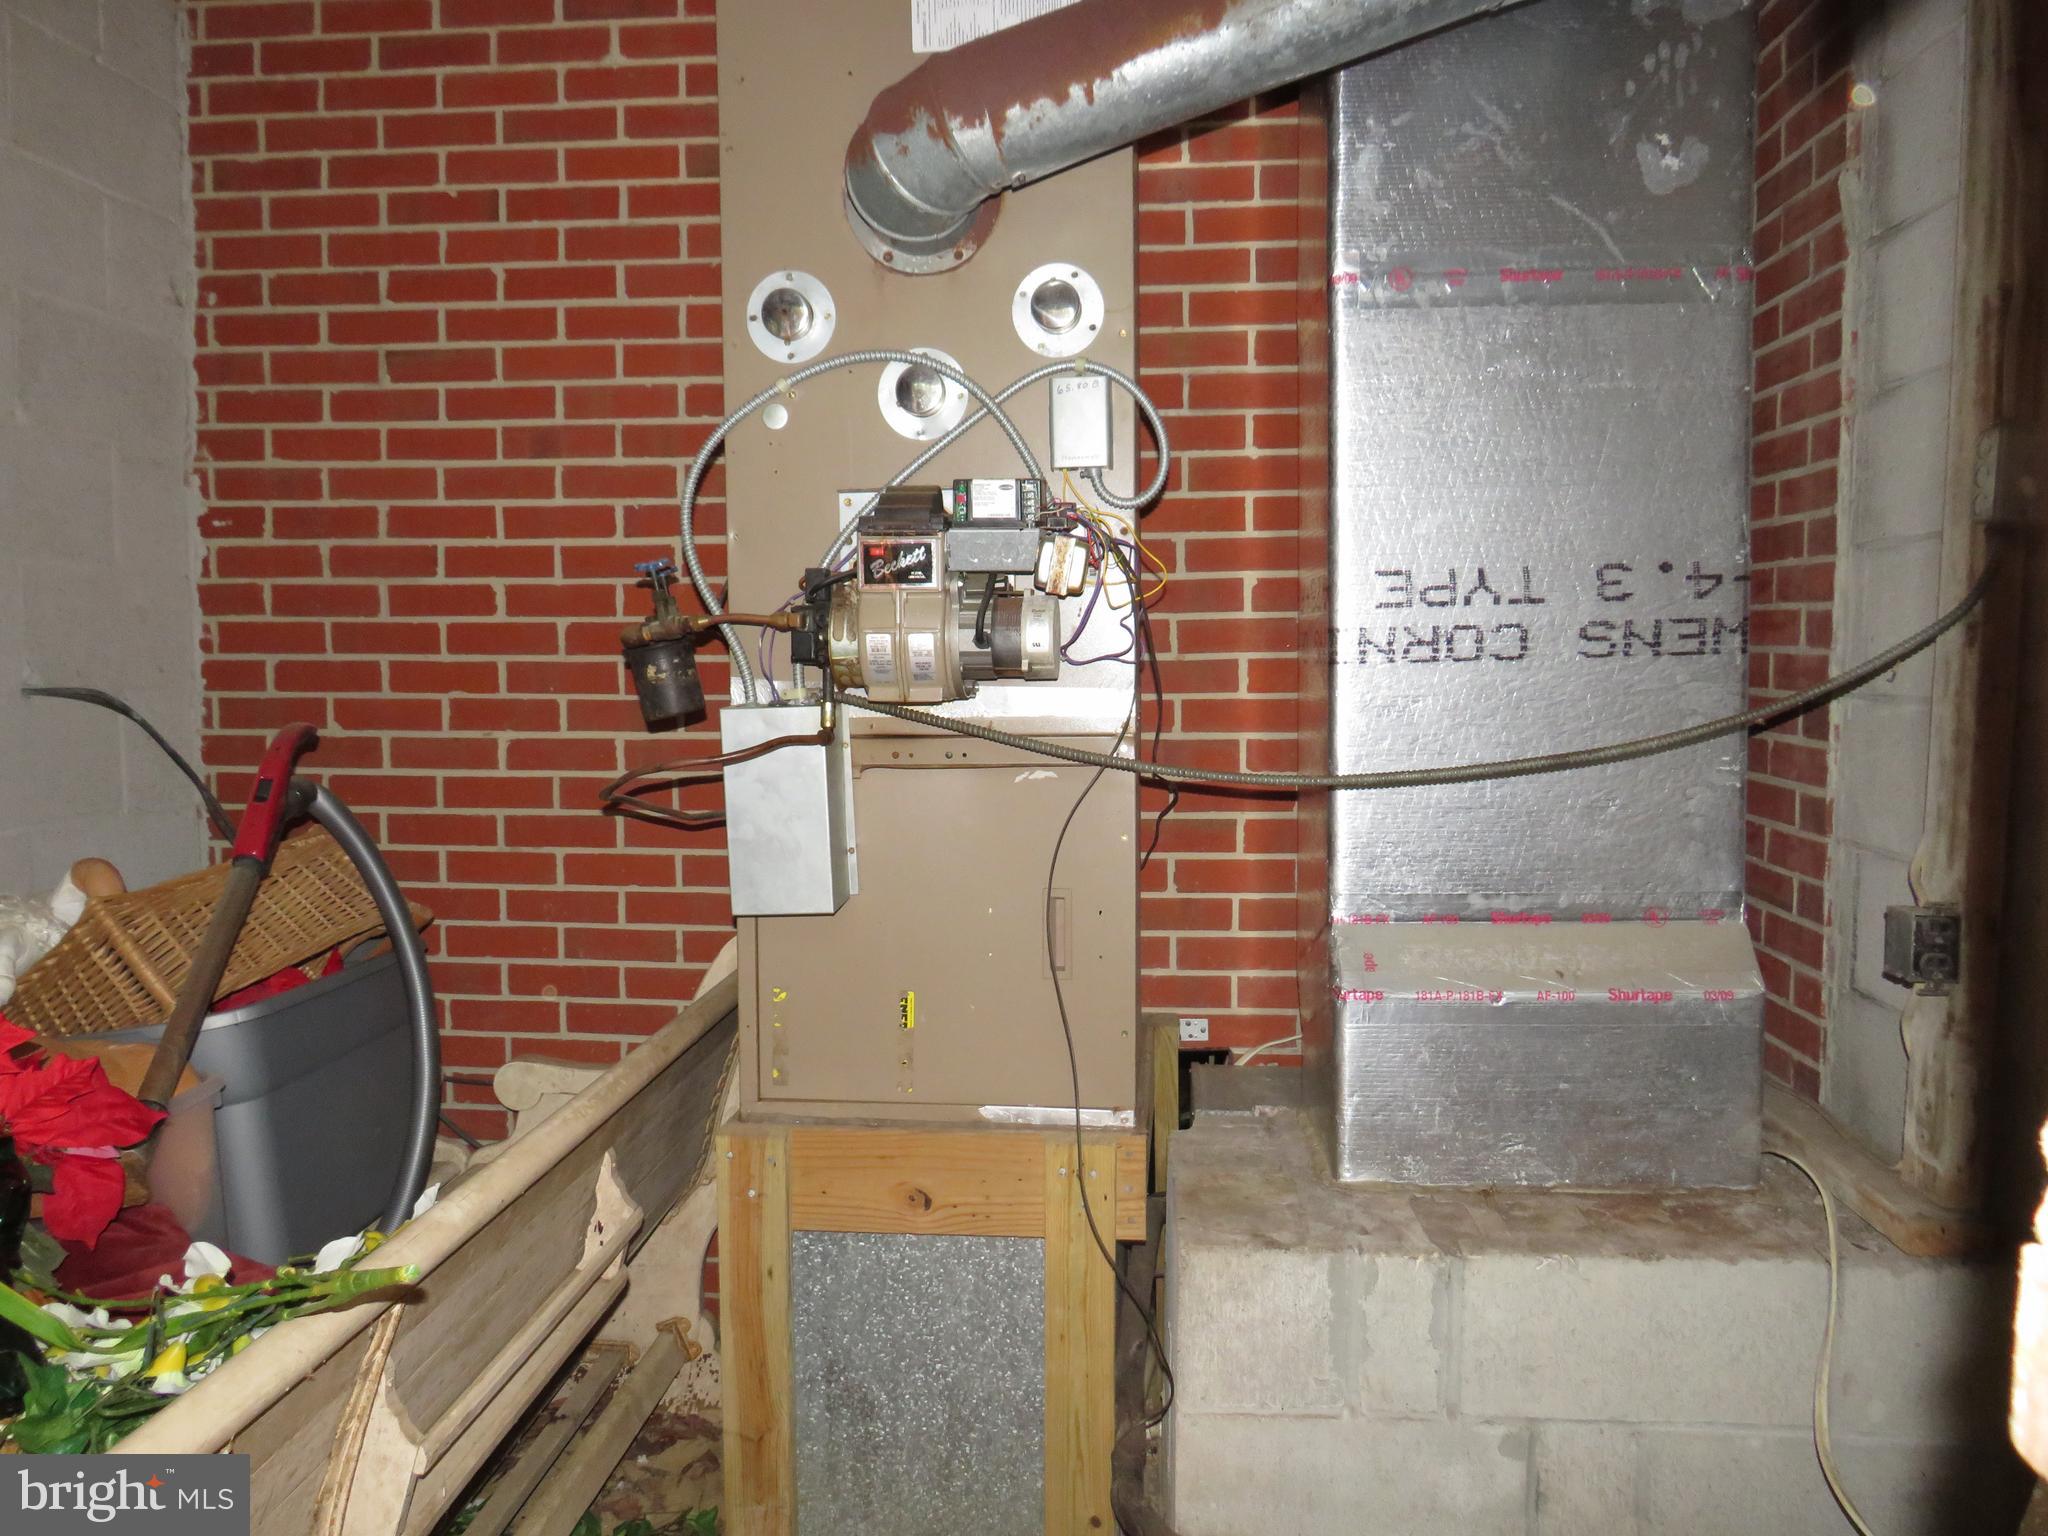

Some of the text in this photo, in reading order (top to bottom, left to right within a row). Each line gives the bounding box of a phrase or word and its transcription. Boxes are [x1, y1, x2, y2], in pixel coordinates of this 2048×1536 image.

[870, 545, 927, 580] Beckett
[1375, 566, 1546, 609] TYPE
[1608, 988, 1674, 1004] Shurtape
